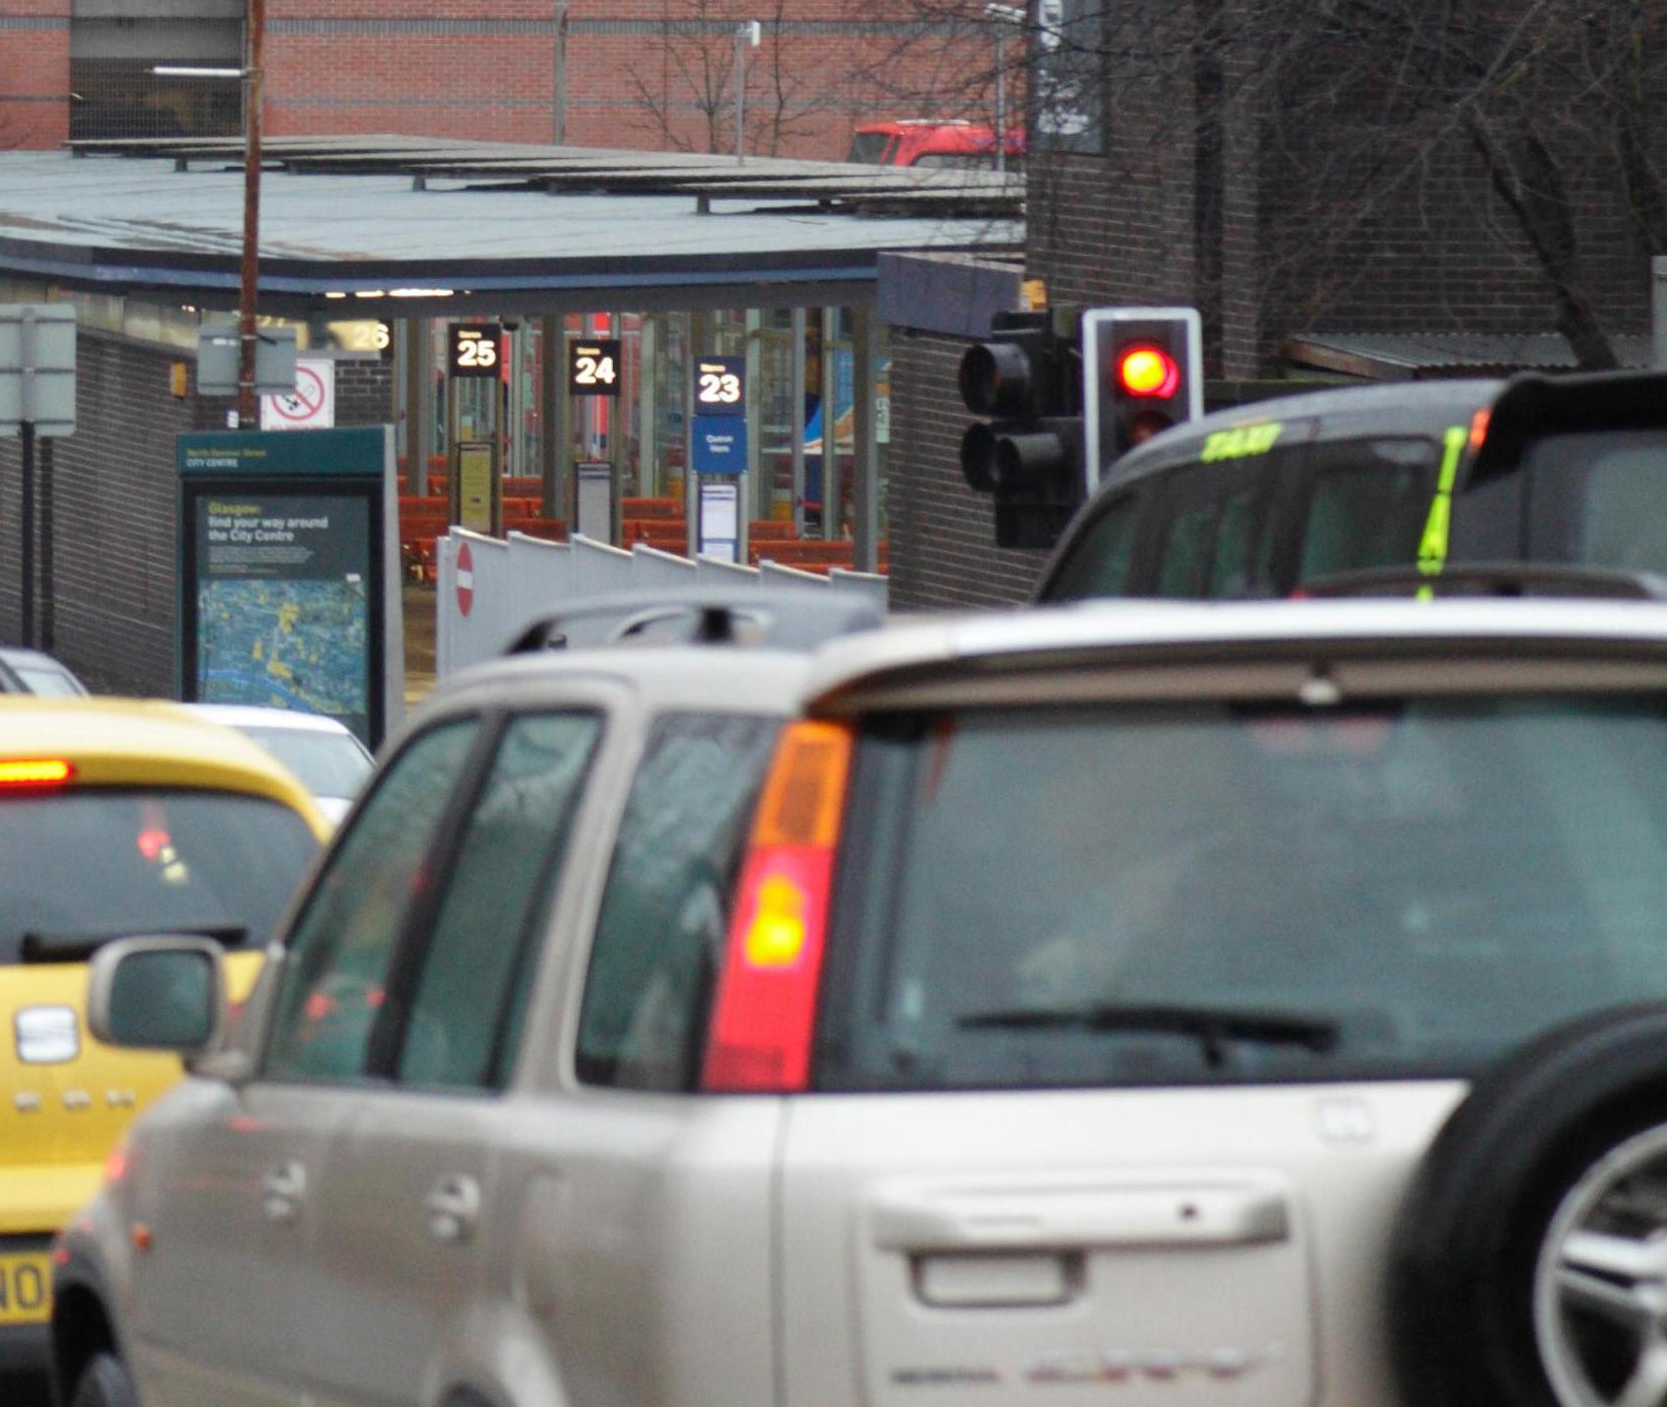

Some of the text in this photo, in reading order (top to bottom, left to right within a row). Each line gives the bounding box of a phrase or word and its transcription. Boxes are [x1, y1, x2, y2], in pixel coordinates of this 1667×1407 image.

[456, 339, 497, 367] 25
[574, 356, 617, 385] 24
[698, 373, 741, 403] 23
[186, 458, 239, 468] CITY CENTRE
[208, 516, 329, 531] find your way around
[208, 529, 295, 544] the City Centre
